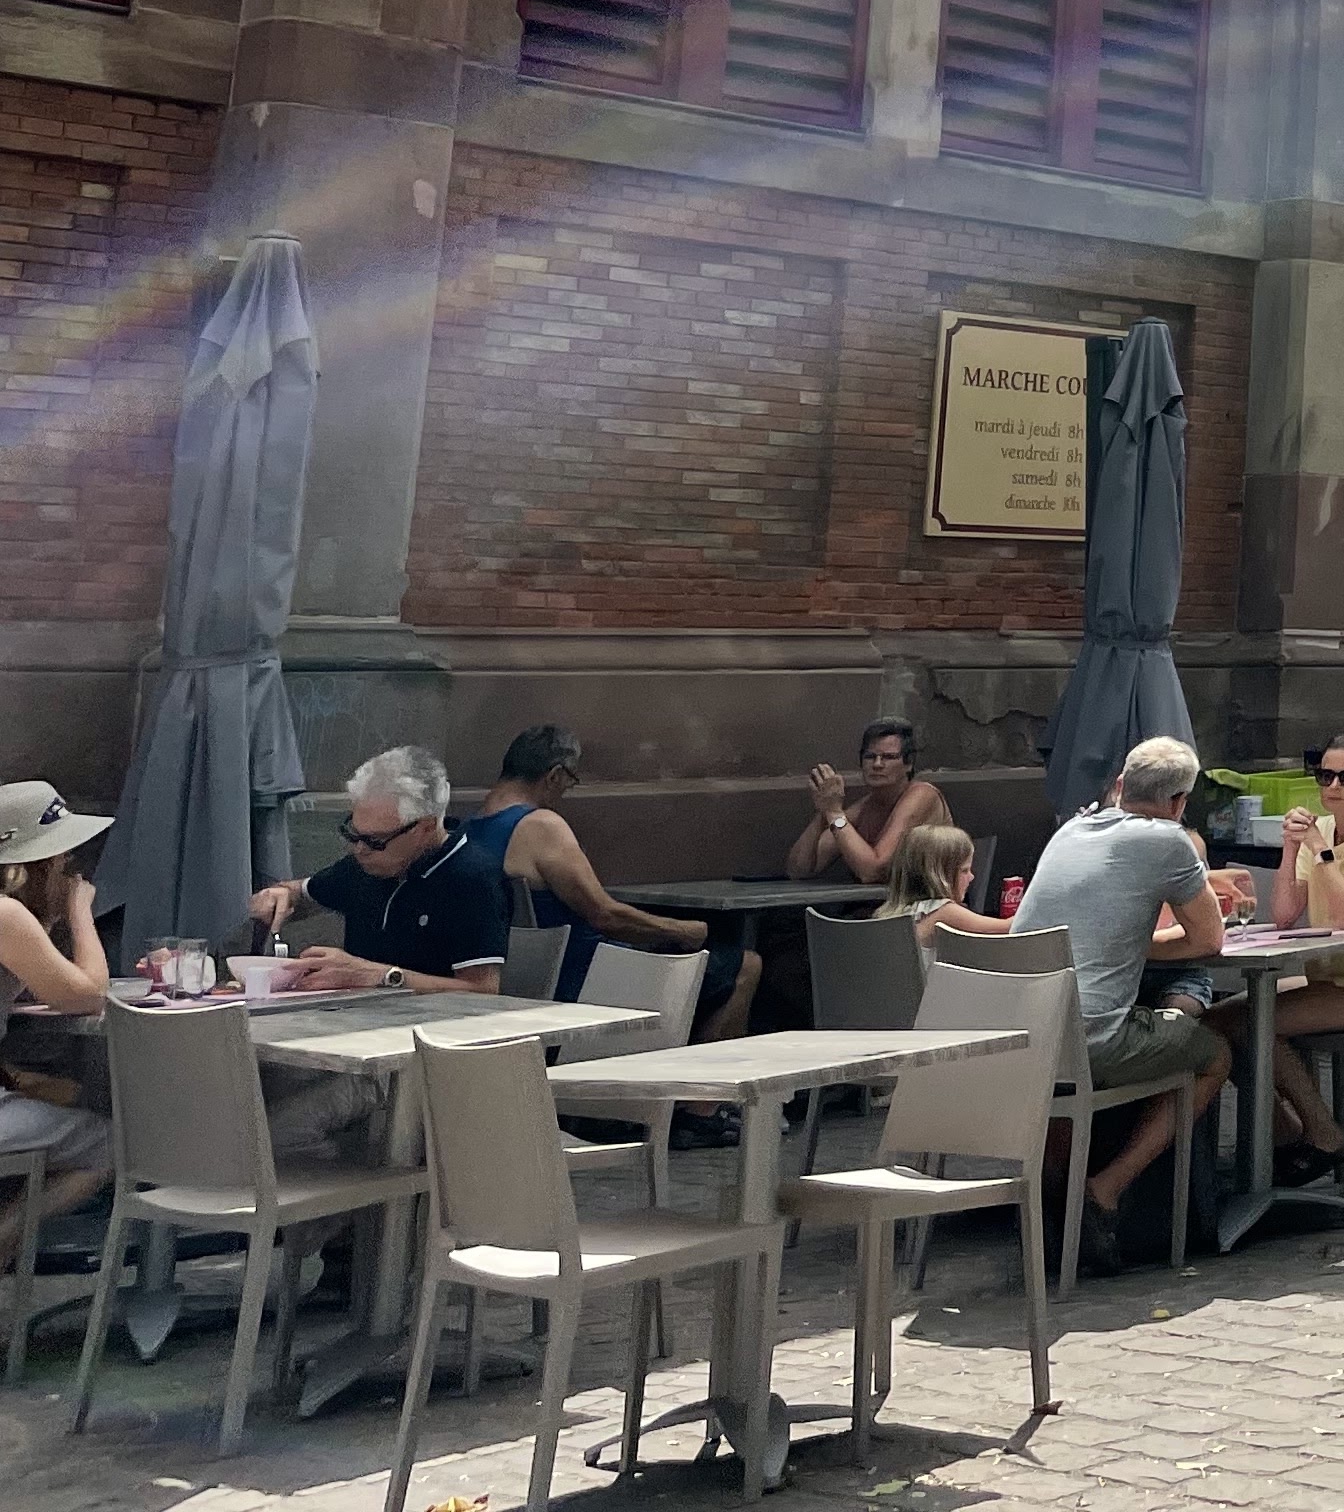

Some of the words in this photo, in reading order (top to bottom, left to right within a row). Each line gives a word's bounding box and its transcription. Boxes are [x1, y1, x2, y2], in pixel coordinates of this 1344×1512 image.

[963, 366, 1050, 393] MARCHE
[974, 417, 1015, 434] mardi
[1017, 419, 1025, 435] à
[1026, 421, 1061, 440] jeudi
[1067, 423, 1084, 439] 8h
[1000, 444, 1060, 462] vendredi
[1066, 446, 1083, 463] 8h
[1011, 469, 1058, 486] samedi
[1065, 471, 1081, 488] 8h
